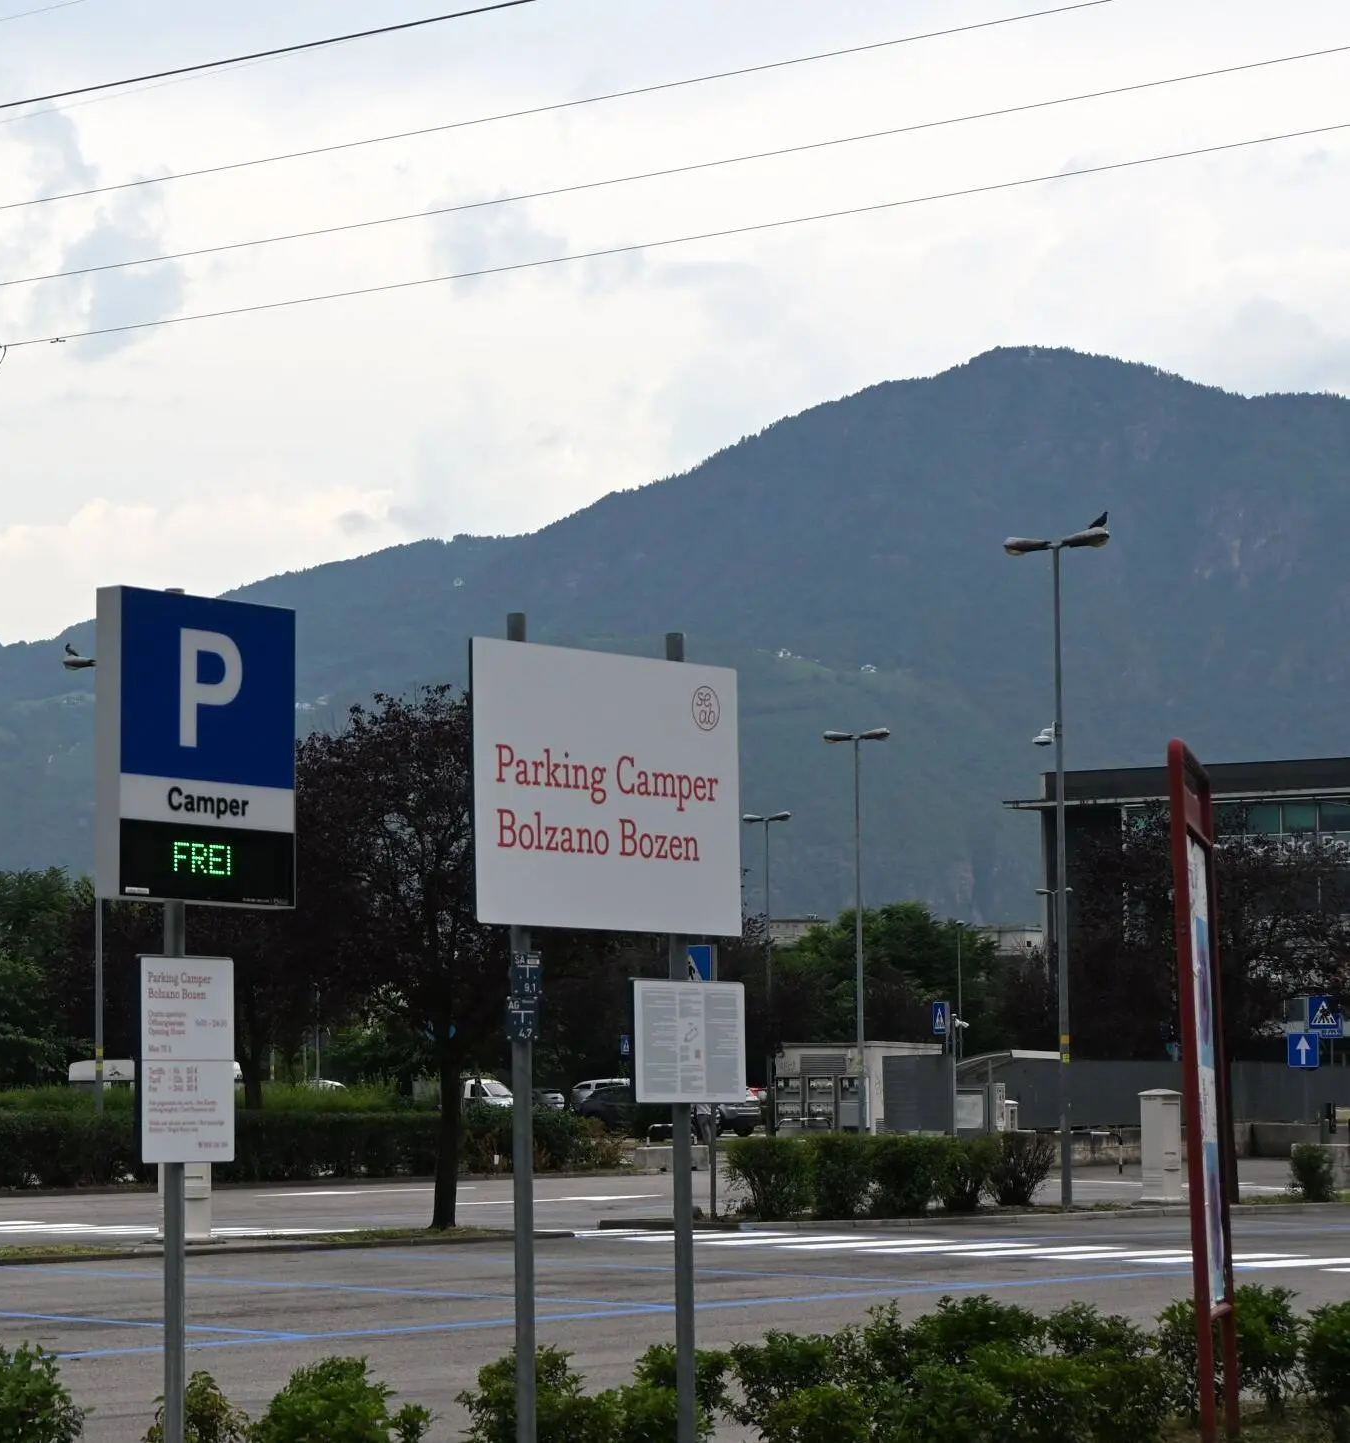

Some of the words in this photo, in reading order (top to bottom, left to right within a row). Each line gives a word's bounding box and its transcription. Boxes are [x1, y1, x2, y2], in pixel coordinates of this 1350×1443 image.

[179, 627, 243, 748] P
[495, 744, 607, 804] Parking
[616, 756, 719, 812] Camper
[167, 786, 250, 819] Camper
[496, 808, 610, 855] Bolzano
[619, 818, 700, 862] Bozen
[173, 841, 232, 876] FREI
[147, 971, 179, 986] Parking
[180, 971, 212, 987] Camper
[147, 987, 180, 999] Bolzano
